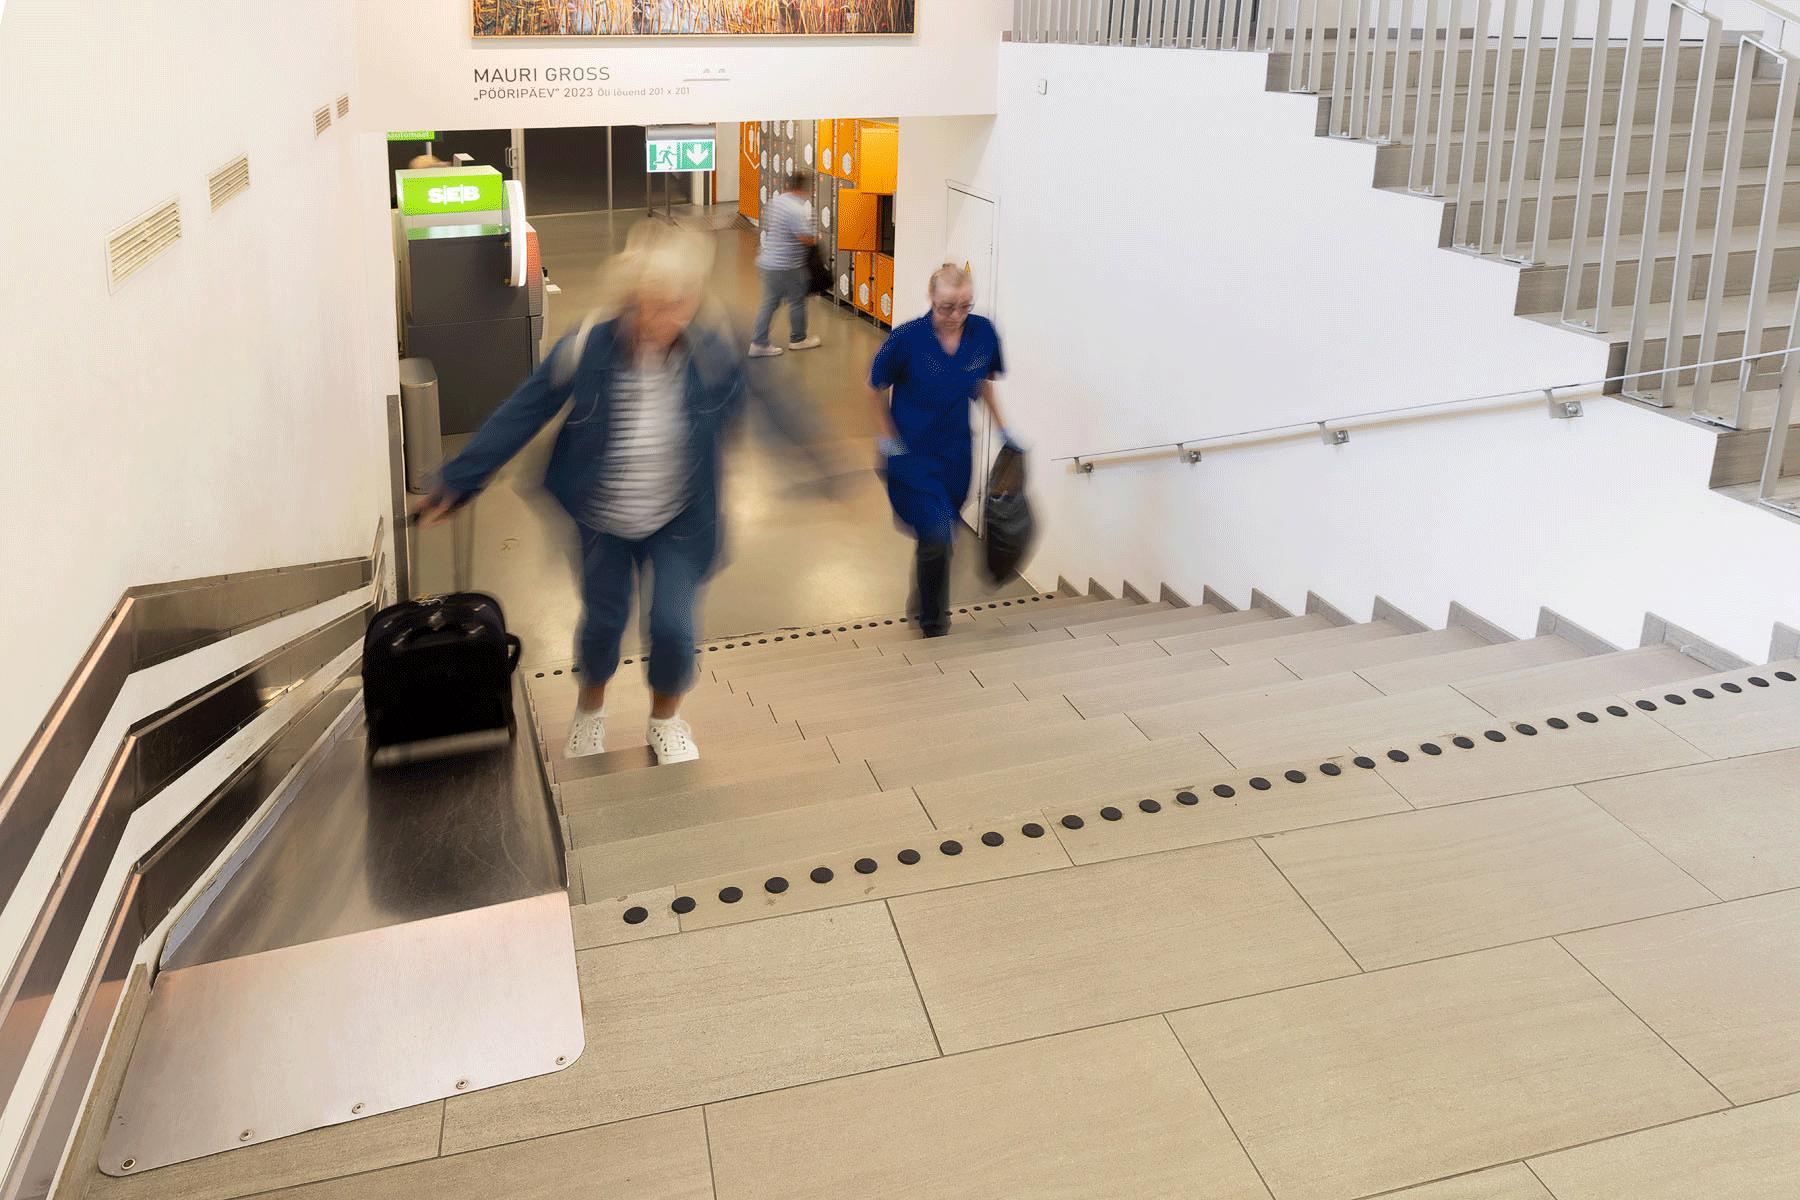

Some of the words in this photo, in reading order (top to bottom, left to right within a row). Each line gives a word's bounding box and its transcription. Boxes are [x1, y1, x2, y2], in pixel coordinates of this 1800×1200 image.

[474, 68, 537, 83] MAURI
[545, 67, 610, 82] GROSS
[564, 87, 593, 98] 2023
[649, 87, 664, 96] 201
[675, 87, 690, 95] 201
[428, 185, 481, 204] SEB
